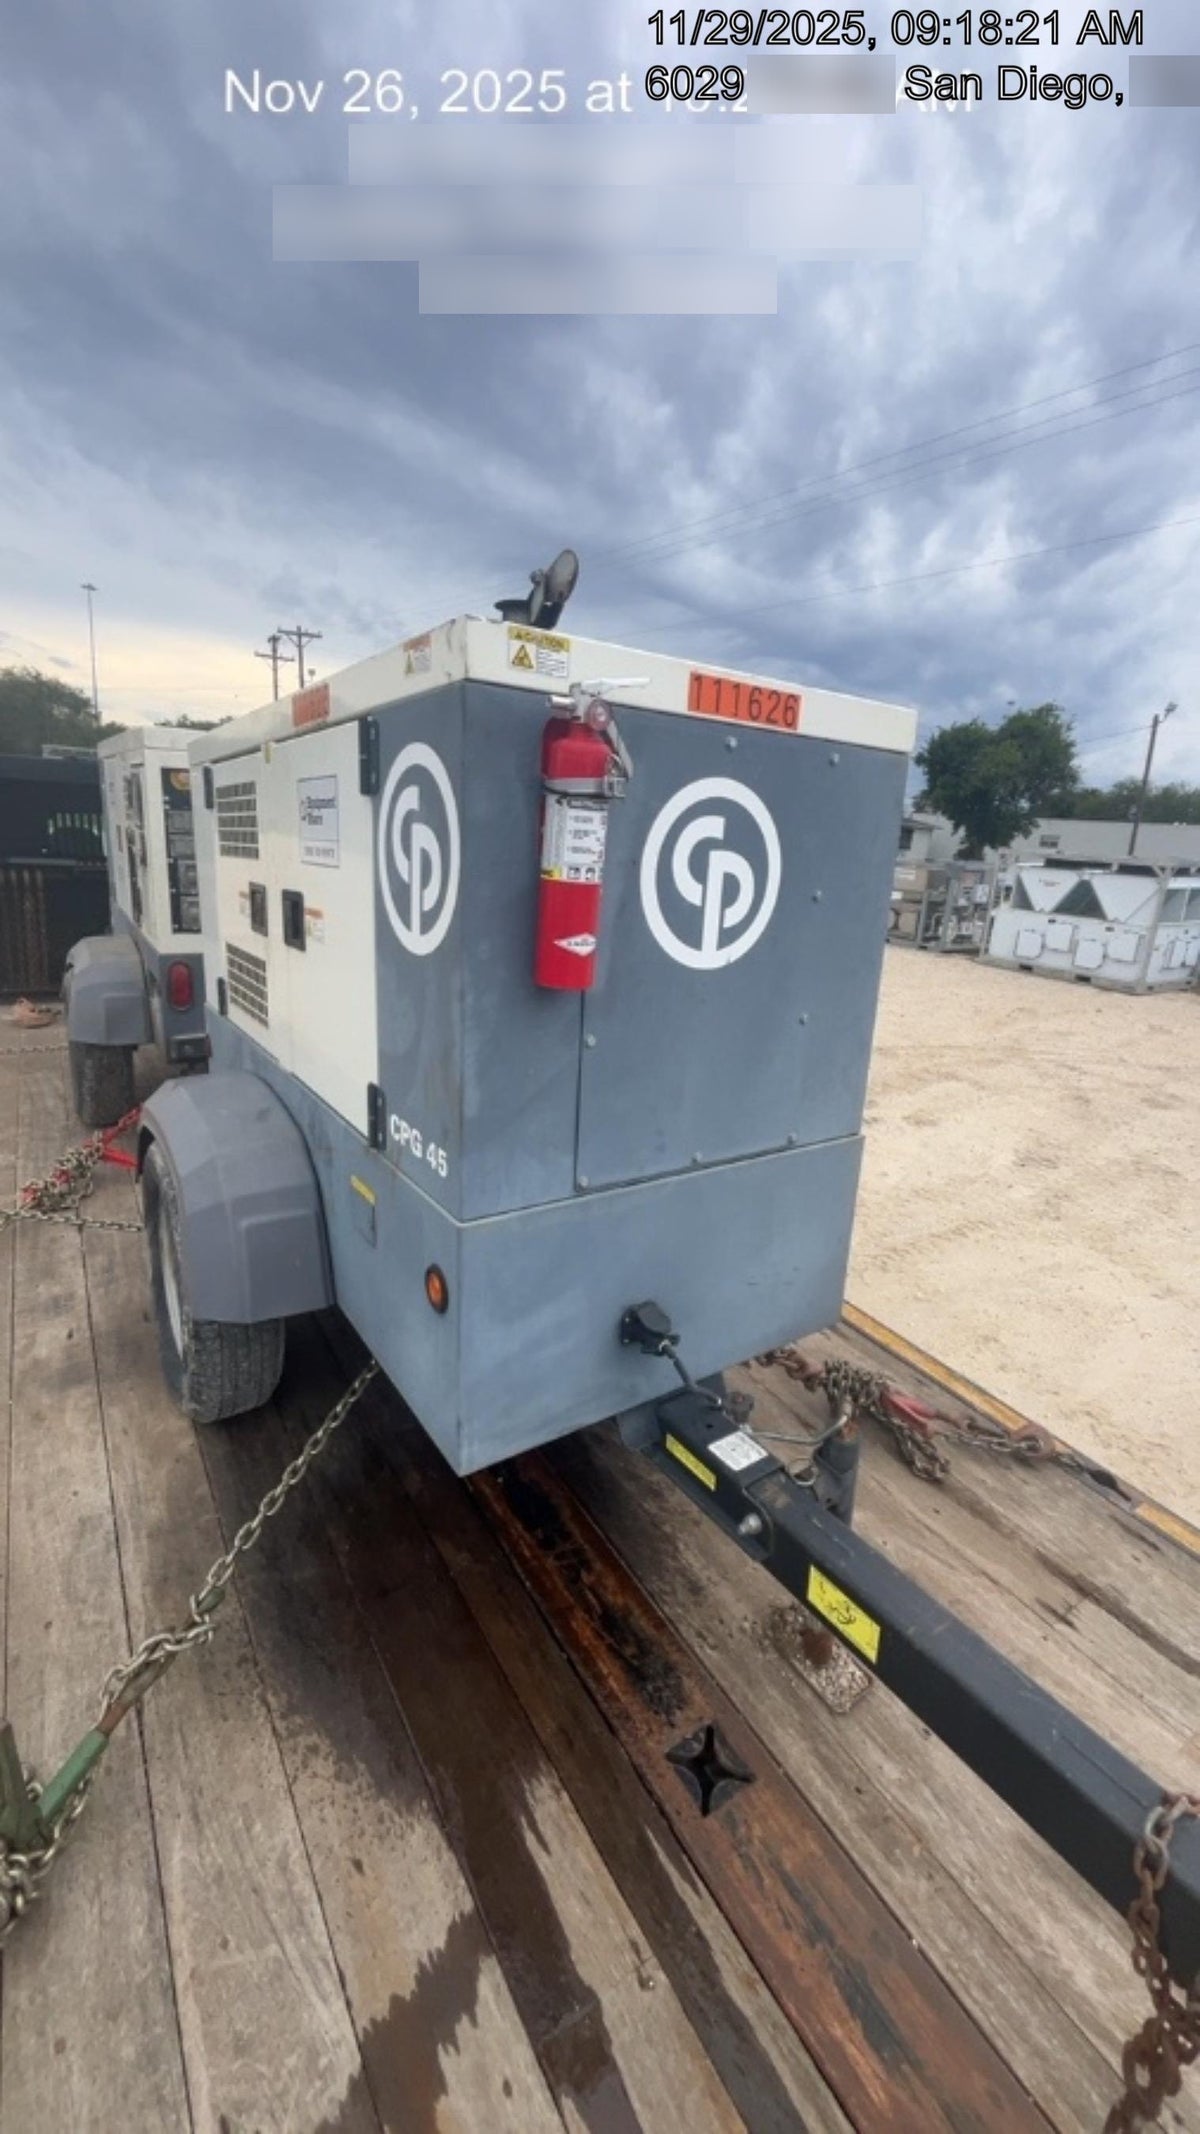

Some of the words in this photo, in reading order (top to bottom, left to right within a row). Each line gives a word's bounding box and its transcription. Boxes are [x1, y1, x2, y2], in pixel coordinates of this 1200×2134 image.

[693, 674, 798, 727] 111626
[390, 1112, 423, 1159] CPG
[426, 1142, 448, 1178] 45
